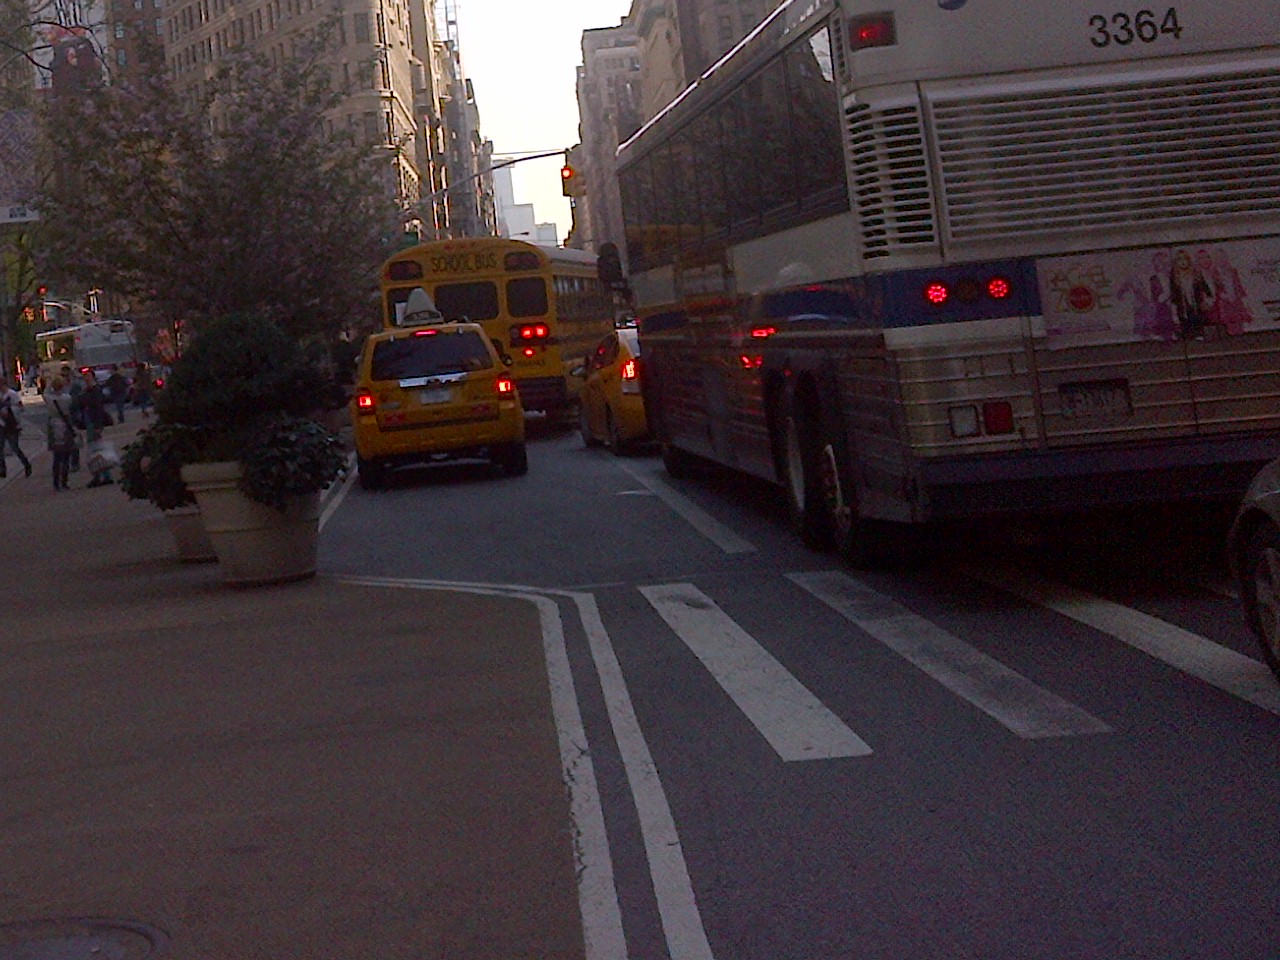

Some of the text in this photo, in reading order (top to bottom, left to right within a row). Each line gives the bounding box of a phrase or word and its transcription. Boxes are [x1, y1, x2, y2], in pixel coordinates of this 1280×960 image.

[1088, 7, 1184, 48] 3364
[431, 251, 497, 273] SCHOOL BUS
